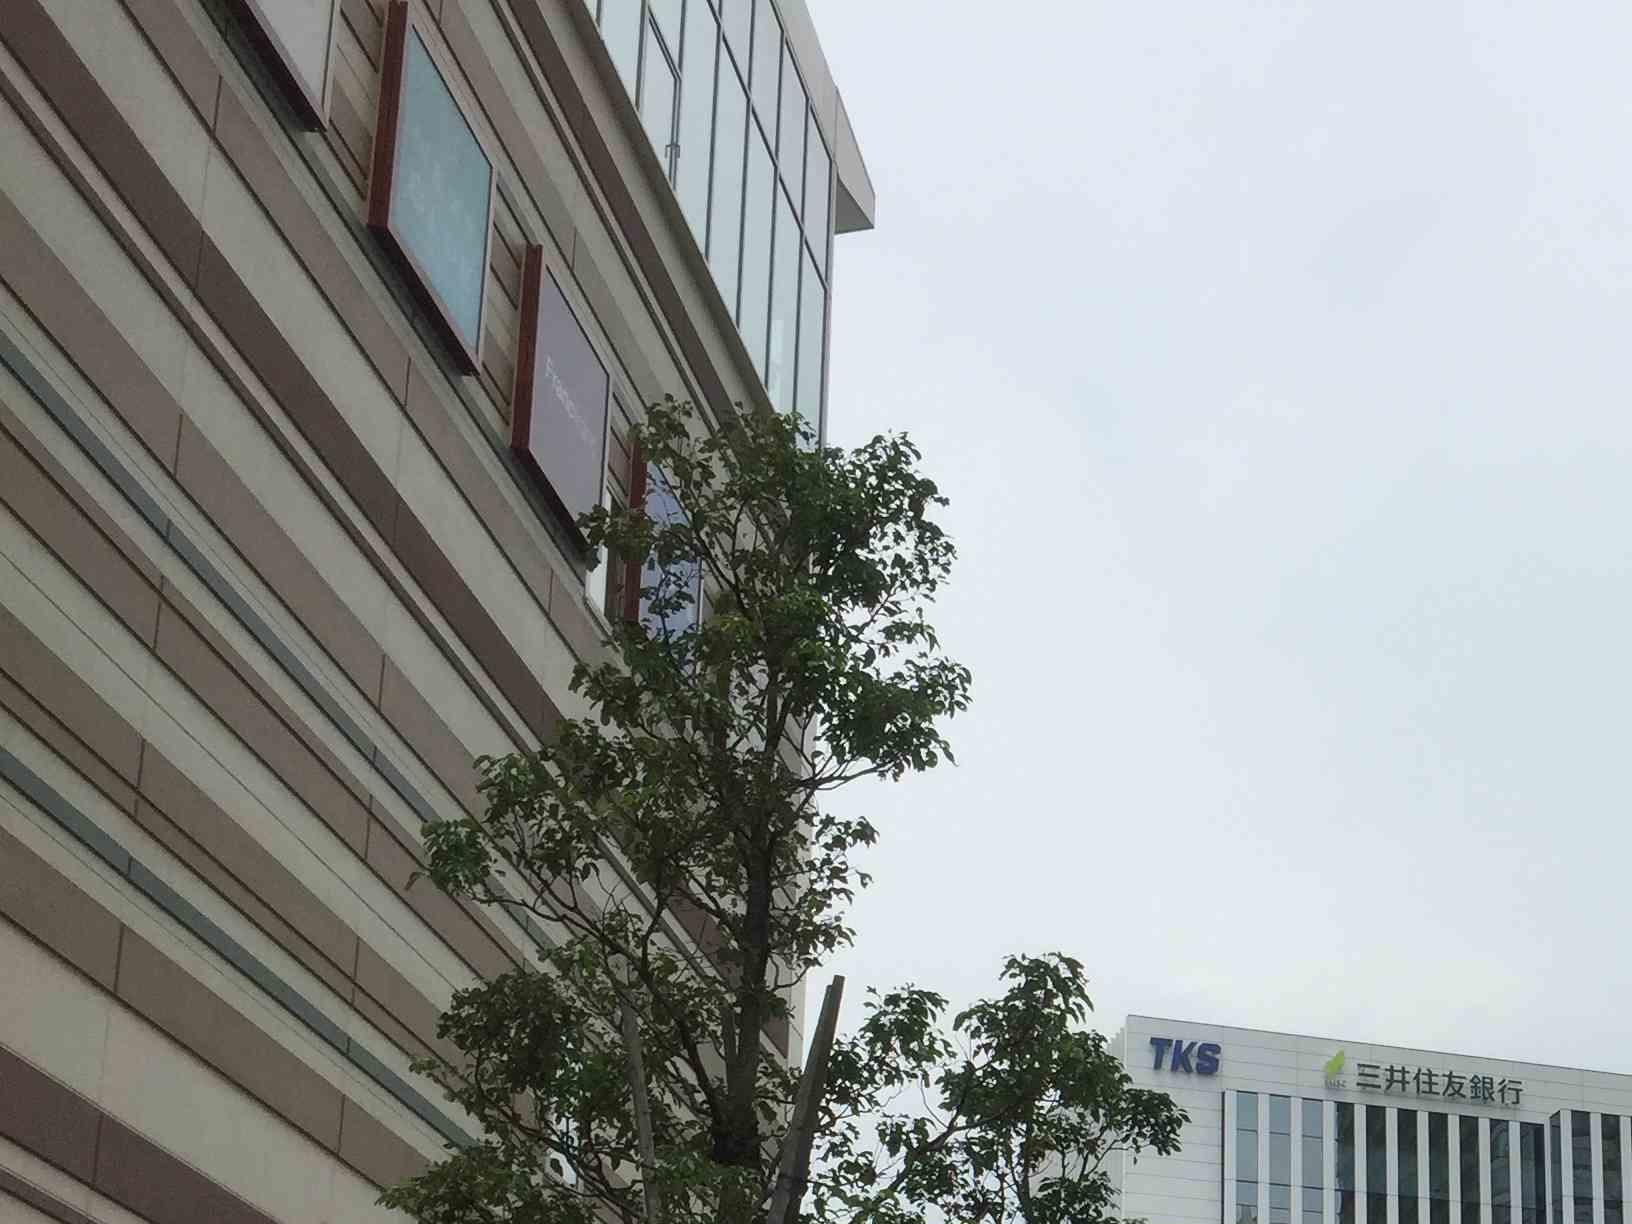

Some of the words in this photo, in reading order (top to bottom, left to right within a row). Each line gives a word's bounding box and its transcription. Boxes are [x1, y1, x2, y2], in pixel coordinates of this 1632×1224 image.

[1150, 1036, 1221, 1075] TKS
[1356, 1063, 1524, 1106] 三井住友銀行
